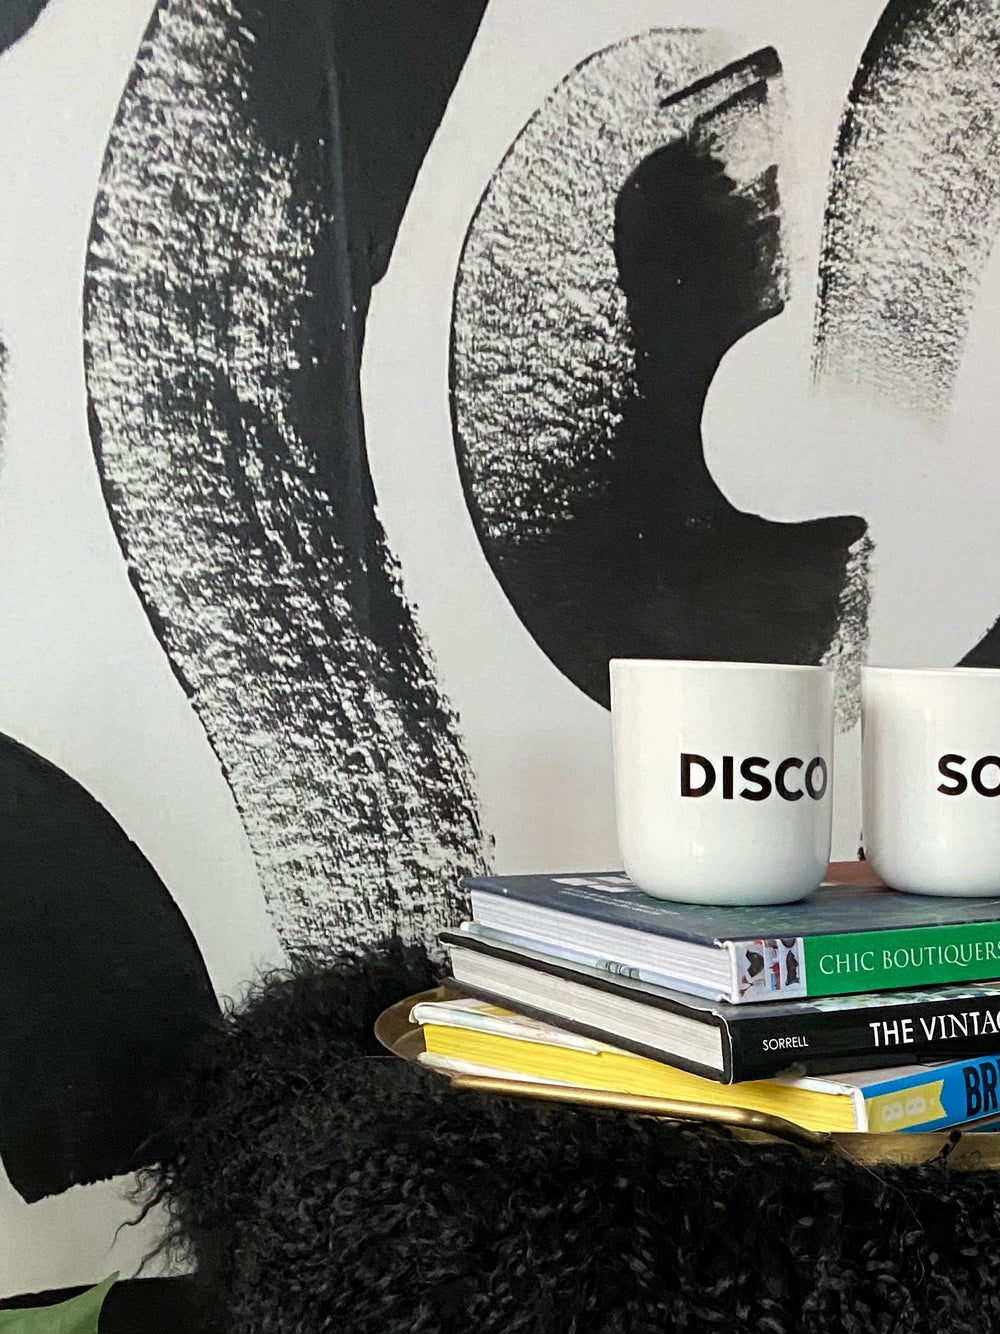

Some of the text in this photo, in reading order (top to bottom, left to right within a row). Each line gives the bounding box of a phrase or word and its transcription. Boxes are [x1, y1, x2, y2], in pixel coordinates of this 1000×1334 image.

[680, 752, 828, 801] DISCO
[819, 951, 875, 976] CHIC
[762, 1035, 809, 1052] SORRELL
[868, 1018, 915, 1047] THE
